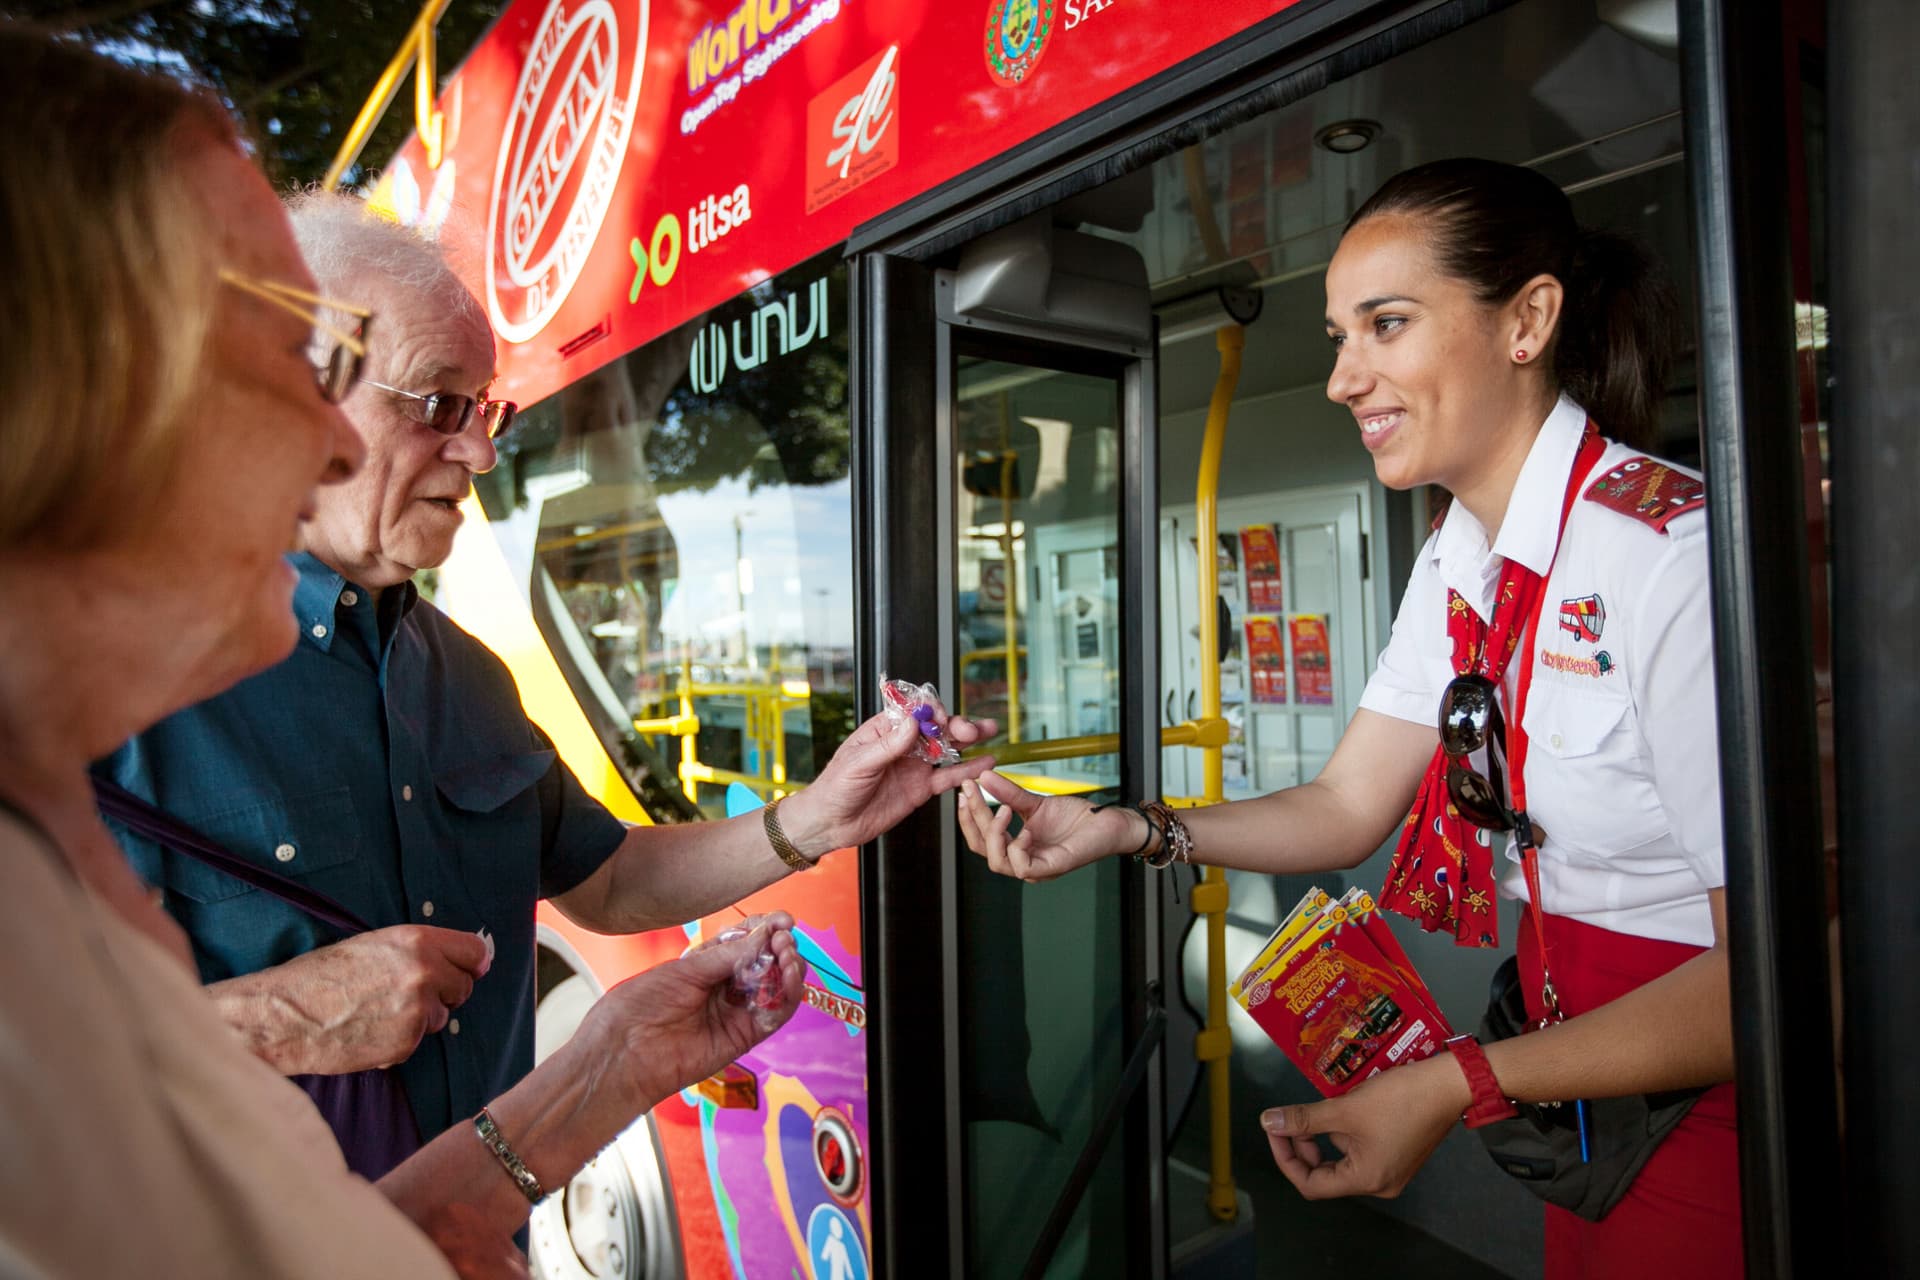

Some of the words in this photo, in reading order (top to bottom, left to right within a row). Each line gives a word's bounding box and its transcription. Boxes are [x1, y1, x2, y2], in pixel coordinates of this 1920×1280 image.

[742, 0, 840, 84] Sightseeing
[1065, 0, 1113, 31] SA
[513, 38, 613, 256] OFICIAL
[526, 273, 550, 319] DE
[552, 95, 628, 288] TENERIFE
[688, 184, 752, 254] titsa
[801, 984, 867, 1029] OLVO
[1286, 960, 1344, 1015] Tenerife
[1390, 1047, 1399, 1057] 8
